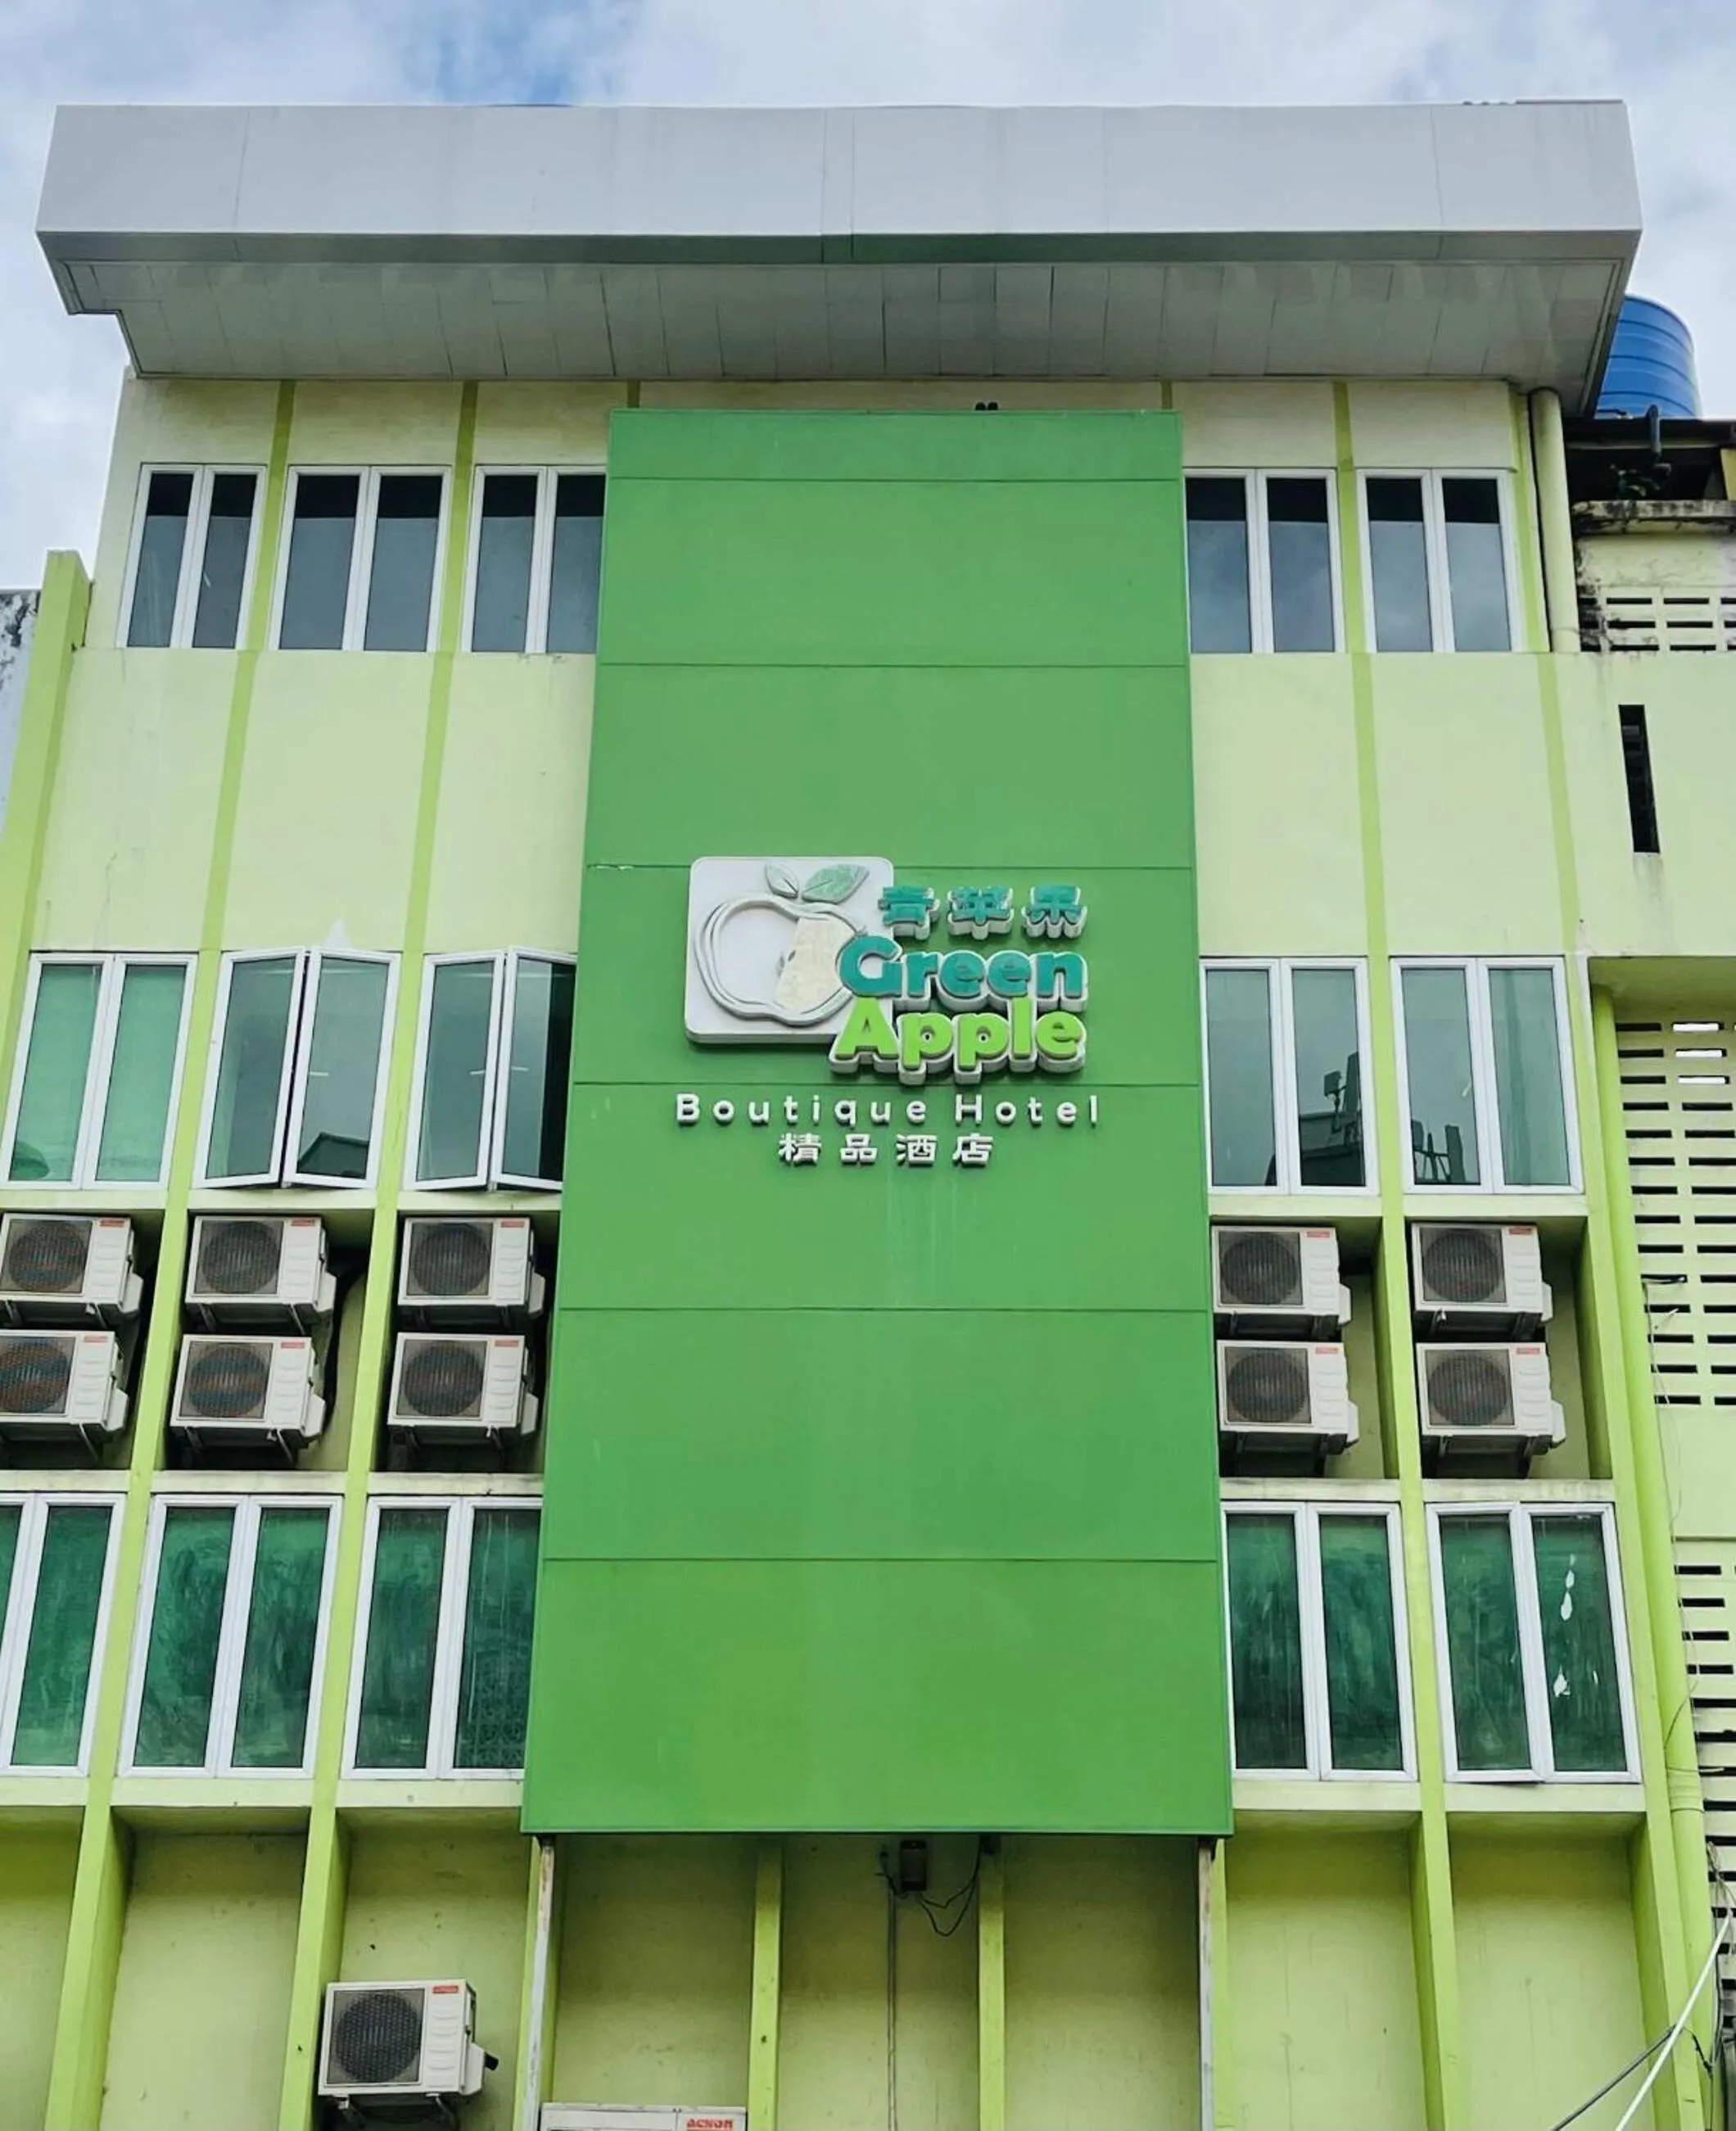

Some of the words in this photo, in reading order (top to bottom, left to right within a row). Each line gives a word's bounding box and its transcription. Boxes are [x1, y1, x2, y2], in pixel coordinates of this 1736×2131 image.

[838, 934, 1089, 1007] Green
[830, 997, 1087, 1084] Apple
[676, 1093, 926, 1126] Boutique
[955, 1093, 1098, 1125] Hotel
[779, 1133, 993, 1165] 精品酒店
